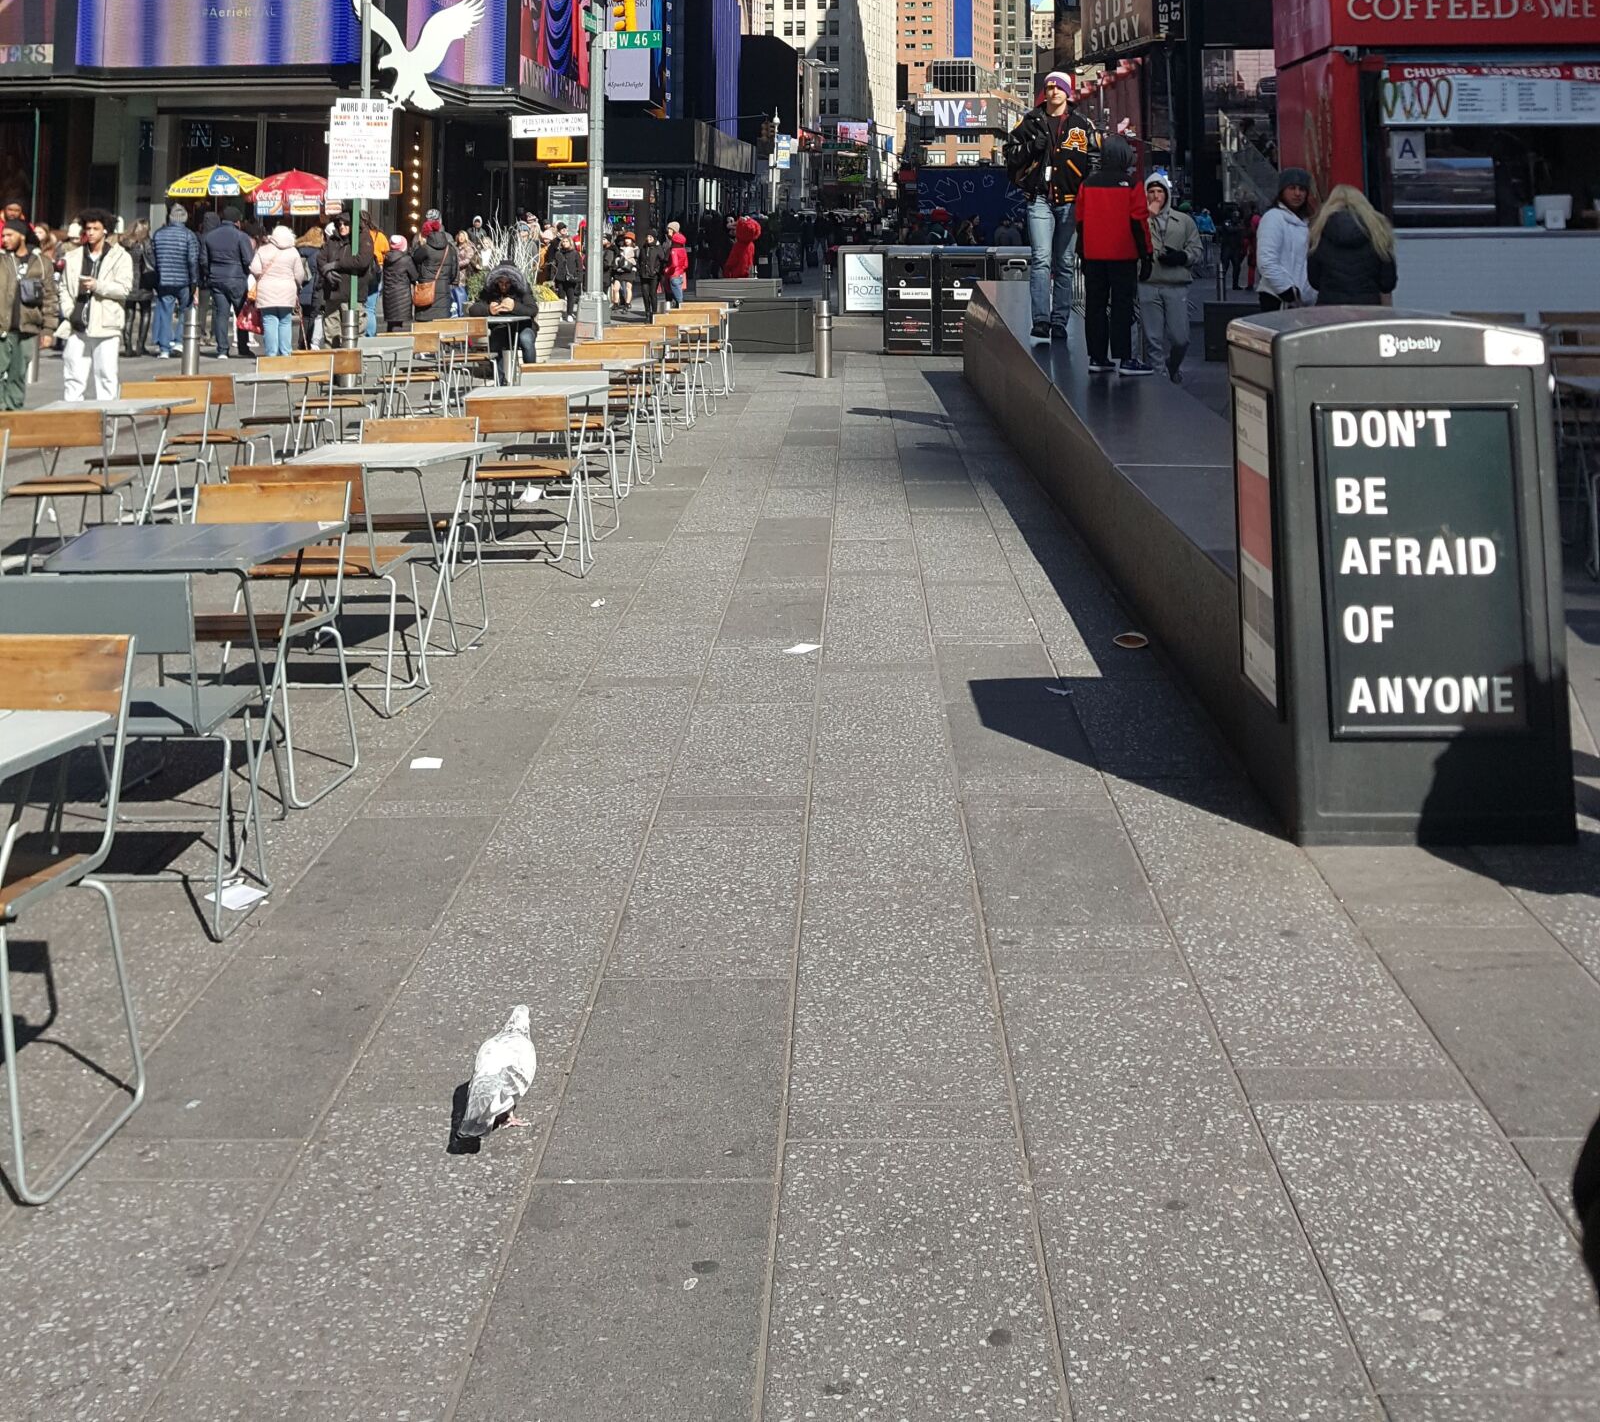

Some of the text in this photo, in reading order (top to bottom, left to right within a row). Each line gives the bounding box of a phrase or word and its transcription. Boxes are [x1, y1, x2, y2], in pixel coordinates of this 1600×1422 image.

[1522, 0, 1536, 12] &
[619, 32, 660, 46] W 46 St
[1091, 14, 1139, 51] STORY
[1403, 66, 1467, 79] CHURRO
[1481, 66, 1561, 78] ESPRESSO
[340, 102, 358, 112] WORD
[372, 102, 384, 112] GOD
[933, 100, 966, 127] NY
[1398, 138, 1417, 158] A
[1379, 334, 1441, 358] Bigbelly
[1332, 410, 1451, 447] DON'T
[1335, 477, 1388, 514] BE
[1340, 537, 1497, 576] AFRAID
[1343, 605, 1394, 643] OF
[1347, 676, 1514, 714] ANYONE
